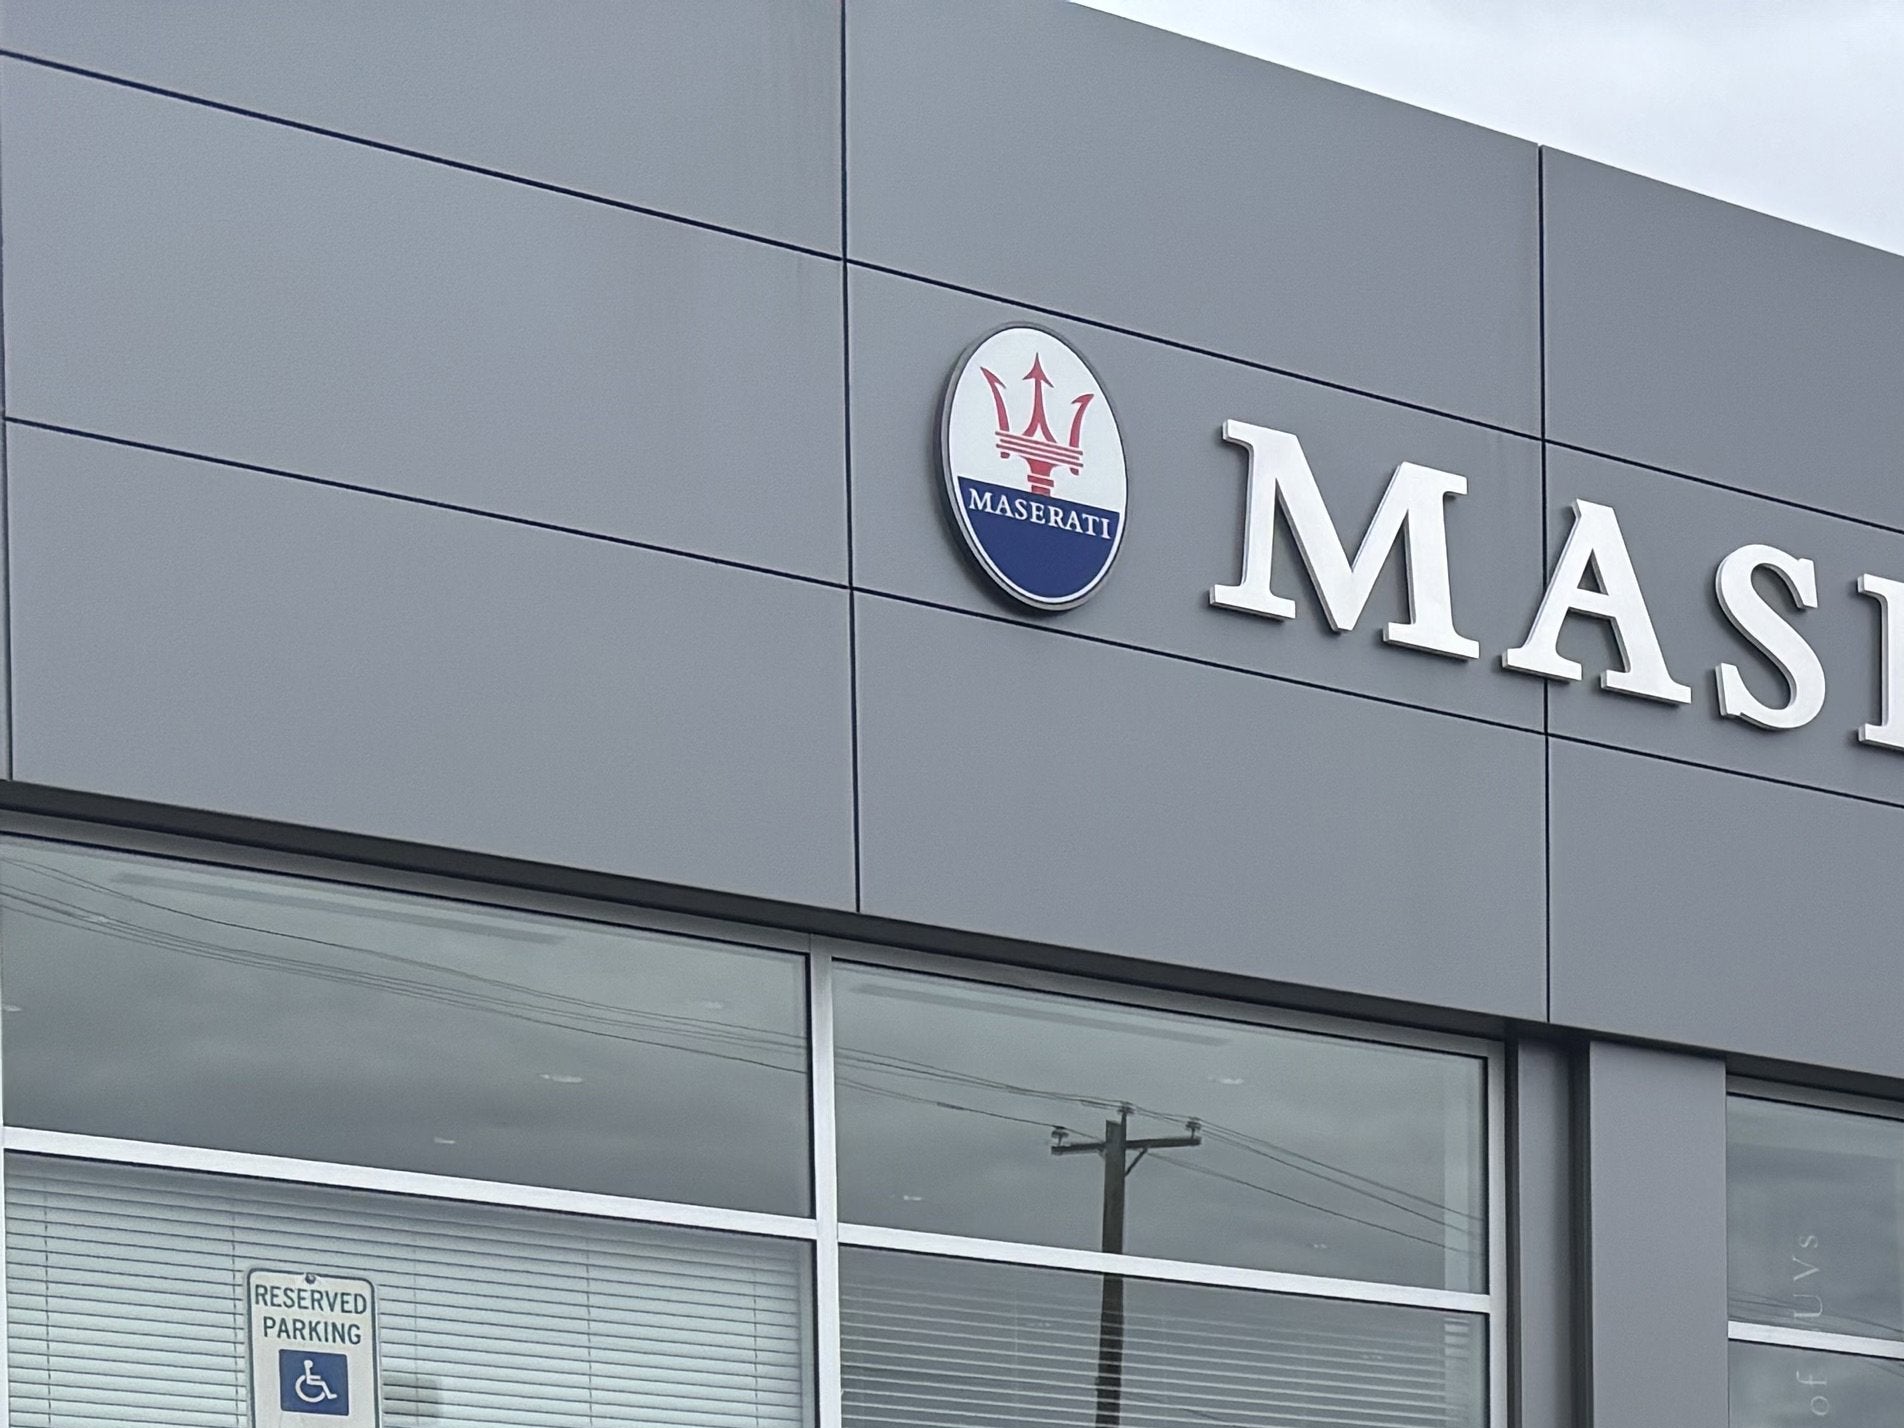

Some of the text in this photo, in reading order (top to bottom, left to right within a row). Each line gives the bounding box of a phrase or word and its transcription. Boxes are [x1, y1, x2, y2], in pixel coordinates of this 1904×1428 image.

[968, 488, 1112, 540] MASERATI
[254, 1284, 367, 1315] RESERVED
[1792, 1235, 1823, 1331] UVs
[263, 1316, 362, 1345] PARKING
[1796, 1370, 1831, 1417] of
